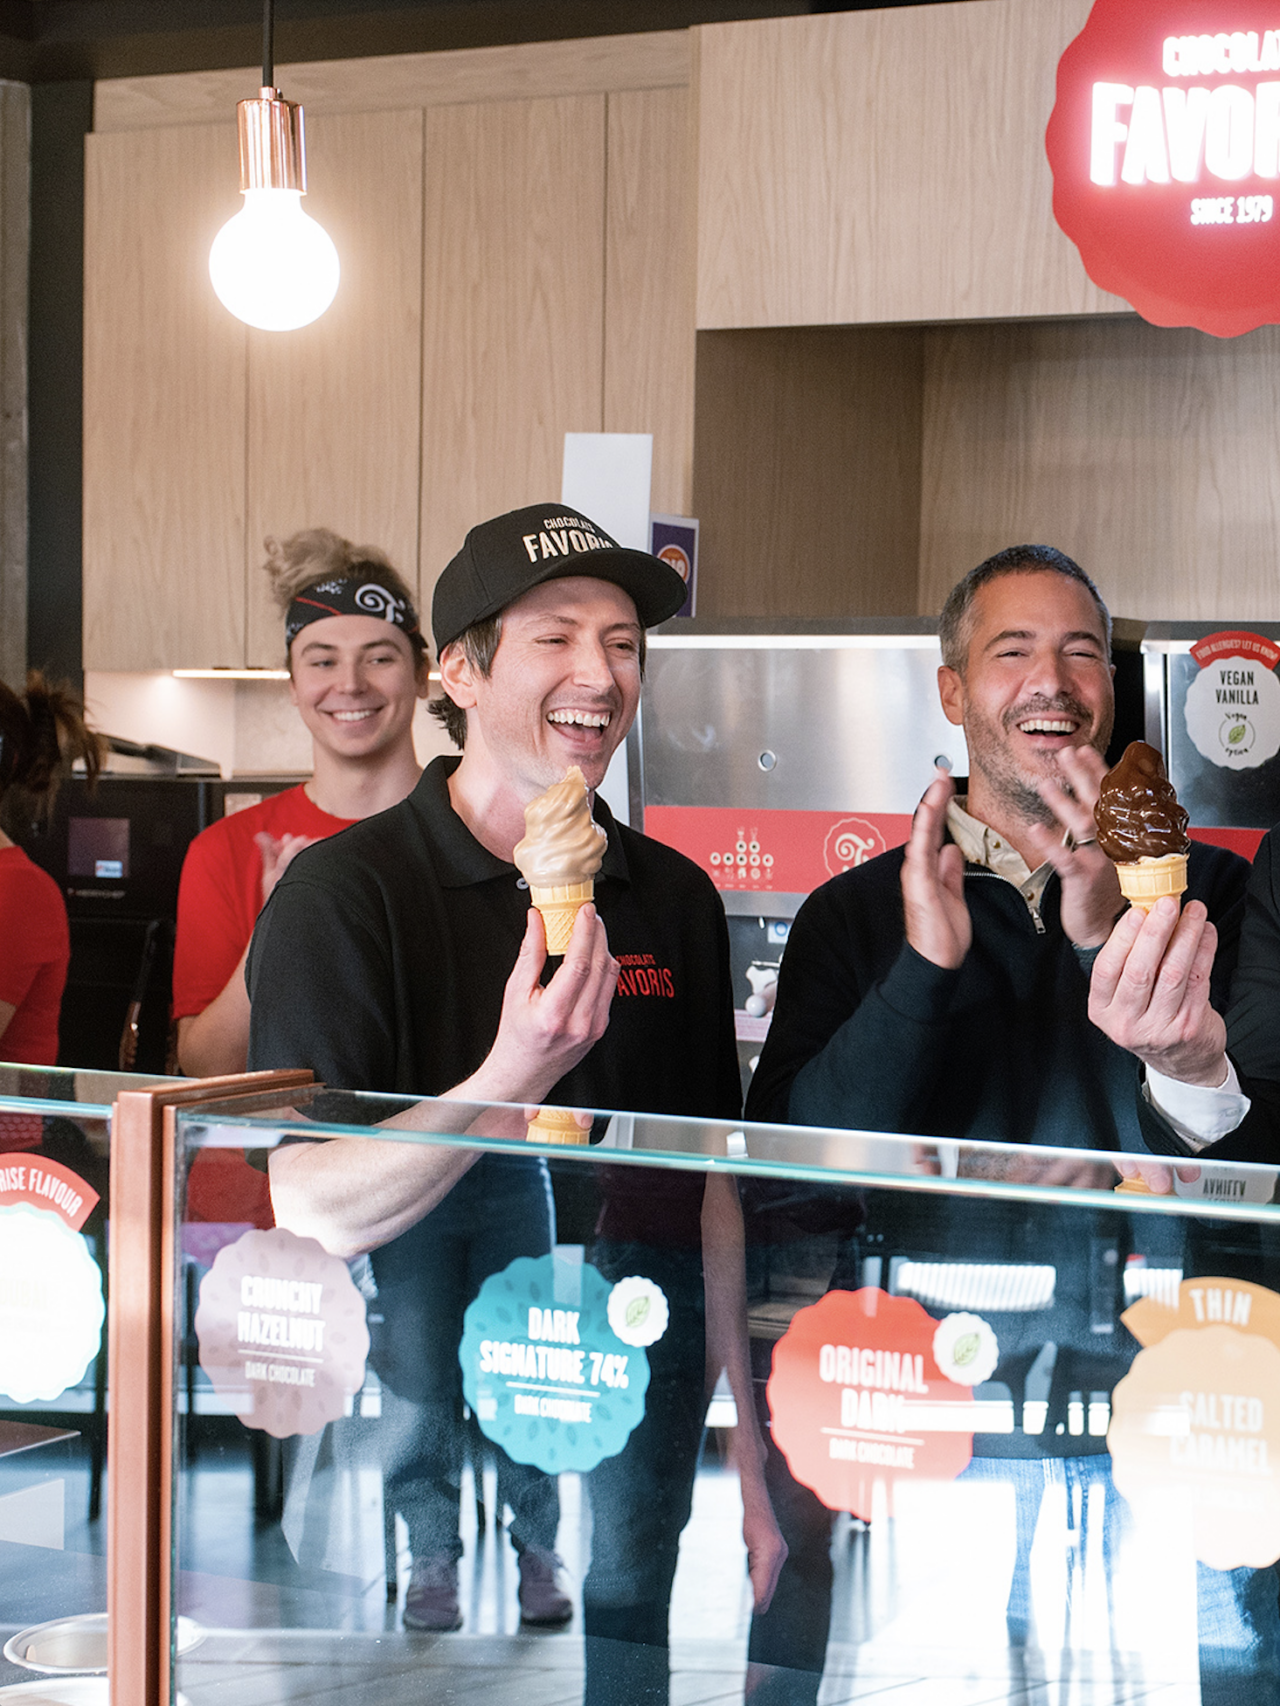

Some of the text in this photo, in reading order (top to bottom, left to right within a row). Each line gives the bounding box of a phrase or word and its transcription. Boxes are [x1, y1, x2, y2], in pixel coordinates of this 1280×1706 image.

[1190, 194, 1274, 225] SINCE 1979
[1215, 689, 1259, 705] VANILLA
[1219, 670, 1254, 686] VEGAN
[616, 968, 675, 998] AVORIS
[28, 1168, 83, 1217] FLAVOUR
[241, 1275, 323, 1314] CRUNCHY
[1189, 1287, 1252, 1326] THIN
[237, 1311, 326, 1351] HAZELNUT
[528, 1306, 580, 1345] DARK
[479, 1339, 629, 1389] SIGNATURE 74%
[819, 1344, 929, 1394] ORIGINAL
